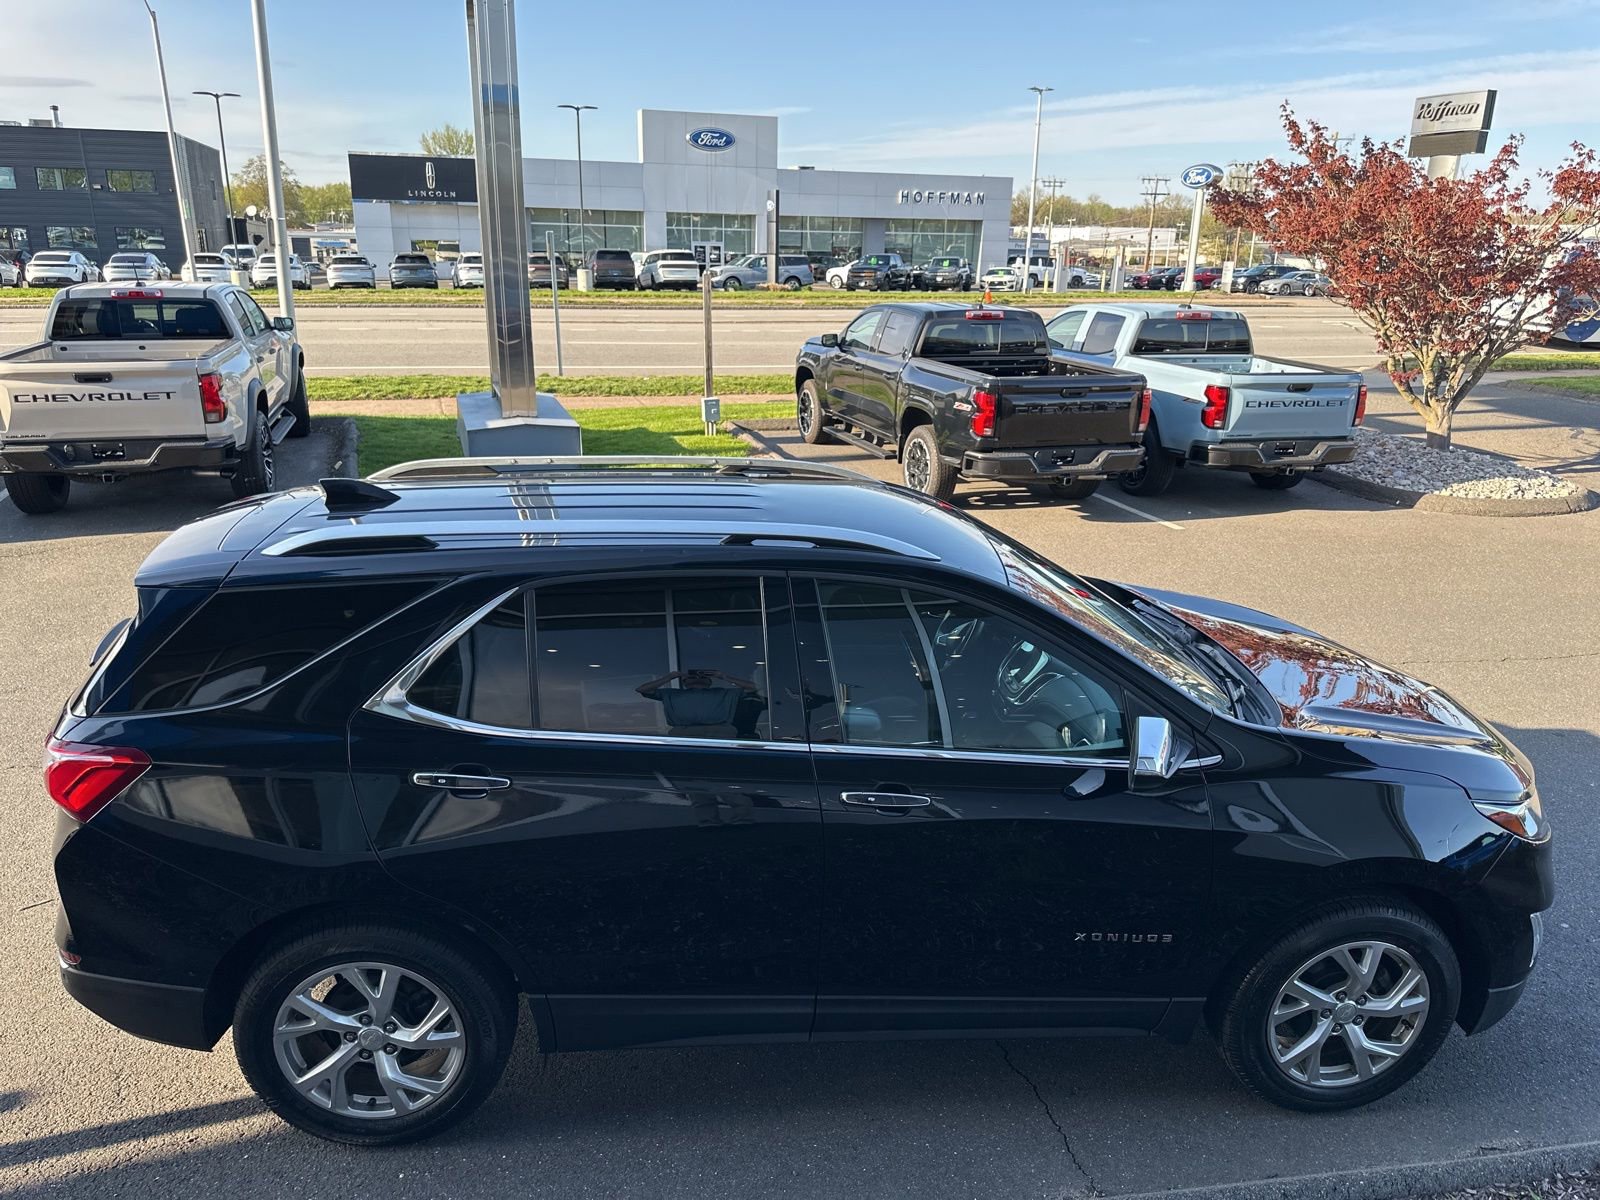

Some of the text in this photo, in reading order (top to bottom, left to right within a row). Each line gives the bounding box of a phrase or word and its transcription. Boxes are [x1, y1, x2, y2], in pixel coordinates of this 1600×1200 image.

[1416, 100, 1480, 122] Hoffman
[697, 132, 727, 147] Ford
[408, 190, 456, 198] LINCOLN
[899, 190, 985, 205] HOFFMAN
[14, 391, 177, 403] CHEVROLET
[1245, 399, 1345, 408] CHEVROLET
